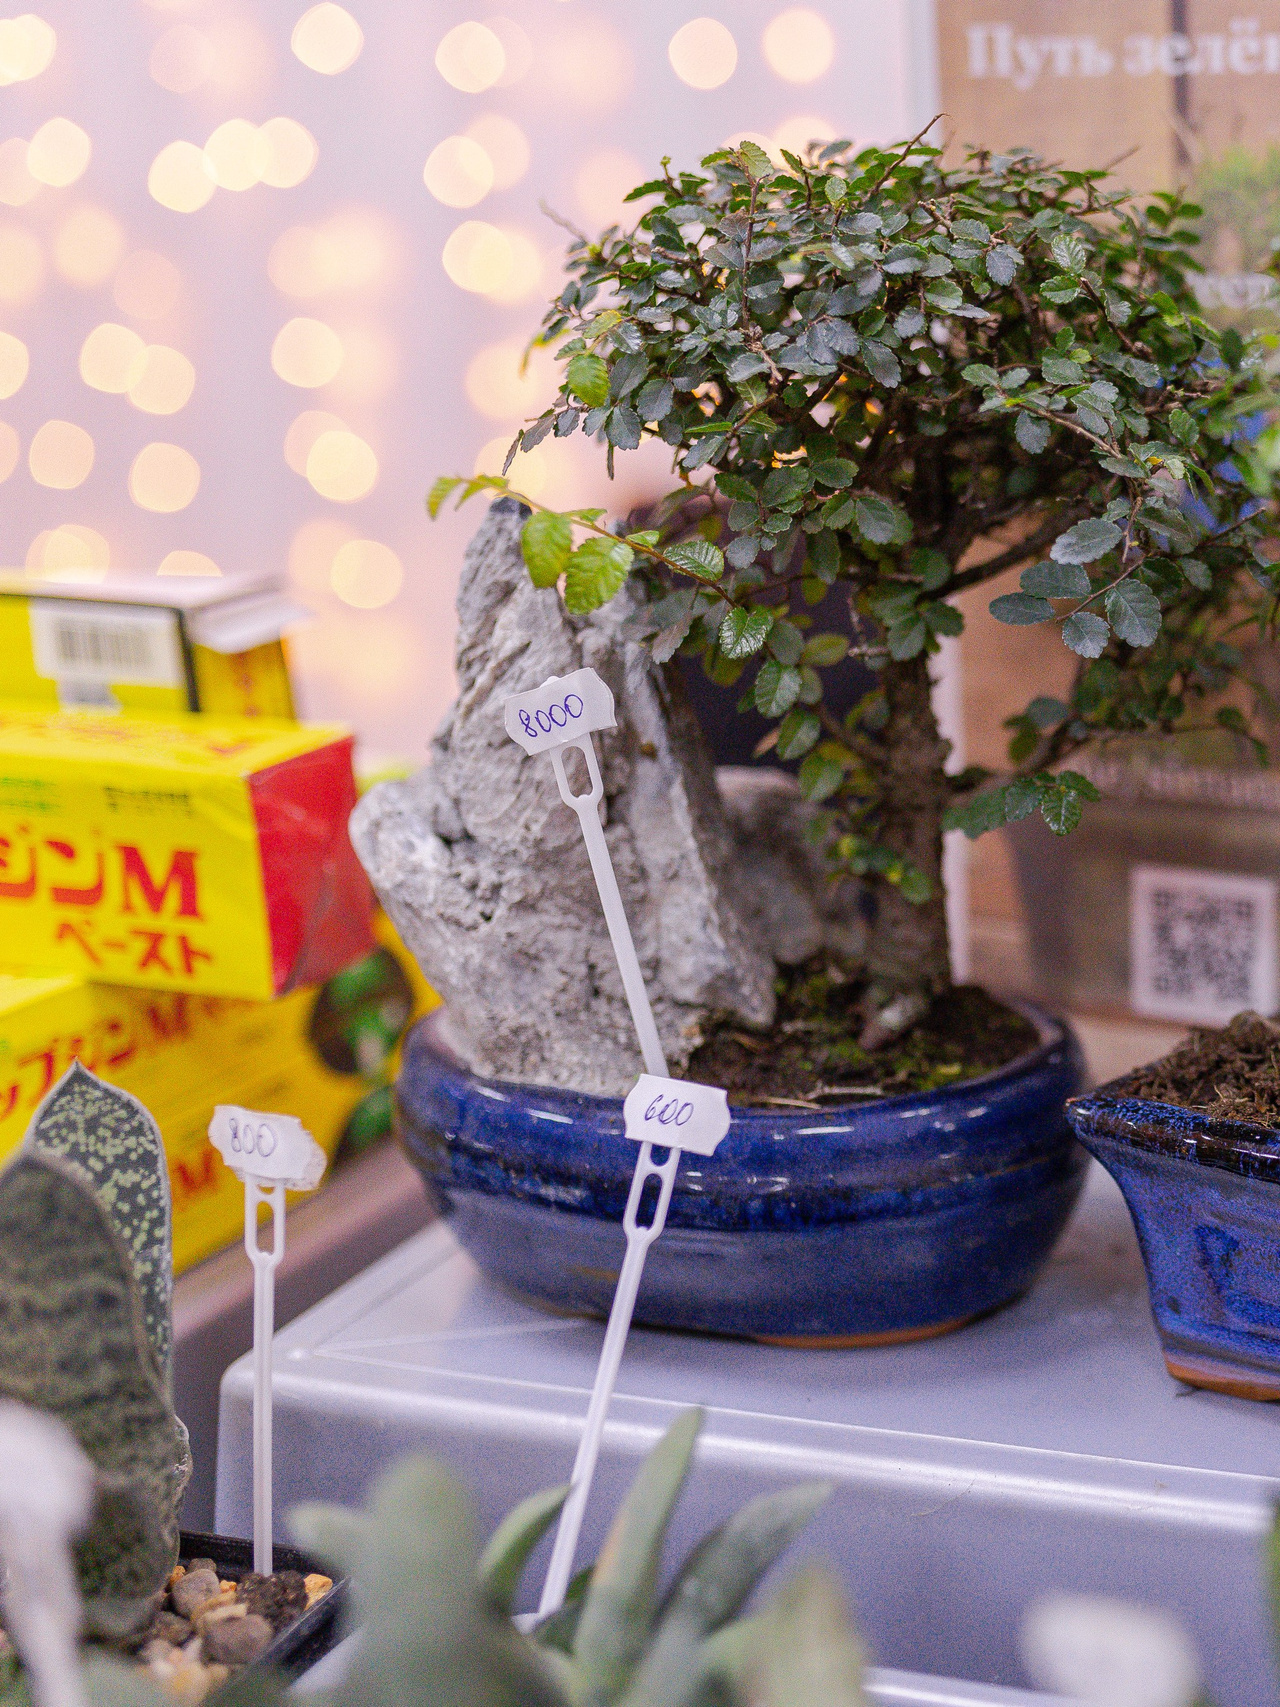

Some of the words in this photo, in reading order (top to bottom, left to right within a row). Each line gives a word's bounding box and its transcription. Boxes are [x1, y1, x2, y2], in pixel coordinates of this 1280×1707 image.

[968, 23, 1114, 90] Путь
[519, 694, 584, 737] 8000
[55, 918, 214, 978] ペースト
[645, 1094, 694, 1126] 600
[229, 1118, 277, 1158] 800
